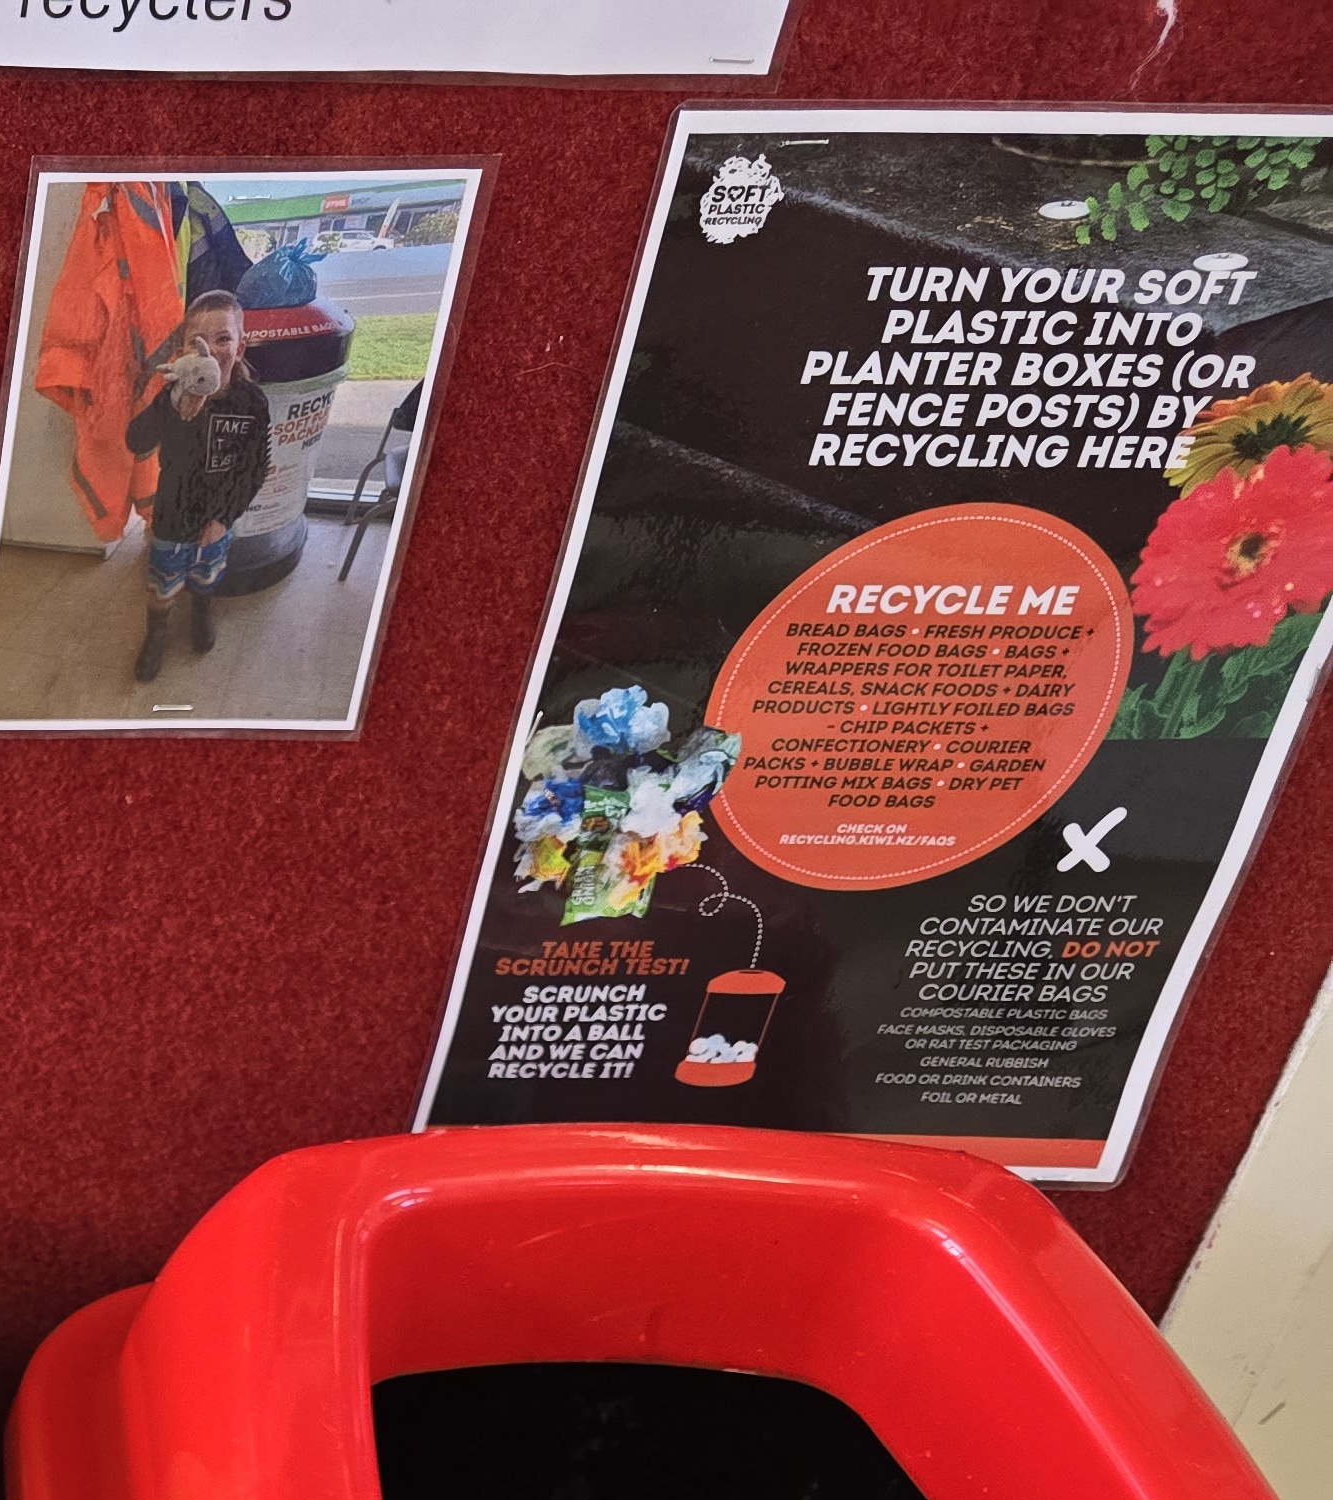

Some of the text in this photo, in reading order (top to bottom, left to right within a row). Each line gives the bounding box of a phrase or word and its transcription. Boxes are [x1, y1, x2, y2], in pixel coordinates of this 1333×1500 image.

[712, 185, 770, 202] SOFT
[708, 204, 765, 215] PLASTIC
[703, 217, 762, 227] RECYCLING
[868, 267, 1257, 304] TURN YOUR SOFT
[881, 310, 1203, 346] PLASTIC INTO
[801, 351, 1256, 390] PLANTER BOXES (OR
[823, 393, 1213, 433] FENCE POSTS) BY
[216, 420, 249, 434] TAKE
[809, 433, 1194, 470] RECYCLING HERE
[827, 585, 1080, 615] RECYCLE ME
[786, 623, 1083, 639] BREAD BAGS FRESH PRODUCE
[797, 642, 1057, 659] FROZEN FOOD BAGS BAGS
[787, 661, 1067, 679] WRAPPERS FOR TOILET PAPER,
[768, 681, 1075, 697] CEREALS, SNACK FOODS DAIRY
[752, 700, 1075, 716] PRODUCTS LIGHTLY FOILED BAGS
[840, 721, 976, 735] CHIP PACKETS
[772, 739, 1031, 754] CONFECTIONERY COURIER
[743, 757, 1046, 772] PACKS BUBBLE WRAP GARDEN
[755, 776, 1024, 790] POTTING MIX BAGS DRY PET
[828, 795, 935, 808] FOOD BAGS
[837, 824, 907, 834] CHECK ON
[968, 895, 1137, 913] SO WE DON'T
[920, 917, 1163, 935] CONTAMINATE OUR
[543, 941, 654, 958] TAKE THE
[1062, 942, 1101, 958] DO
[1105, 941, 1160, 957] NOT
[495, 958, 690, 976] SCRUNCH TEST!
[909, 962, 1134, 980] PUT THESE IN OUR
[523, 984, 646, 1003] SCRUNCH
[919, 984, 1108, 1002] COURIER BAGS
[492, 1004, 667, 1022] YOUR PLASTIC
[499, 1024, 645, 1041] INTO A BALL
[488, 1043, 644, 1060] AND WE CAN
[488, 1062, 634, 1078] RECYCLE IT!
[920, 1056, 1049, 1068] GENERAL RUBBISH
[875, 1073, 1081, 1088] FOOD OR DRINK CONTAINERS
